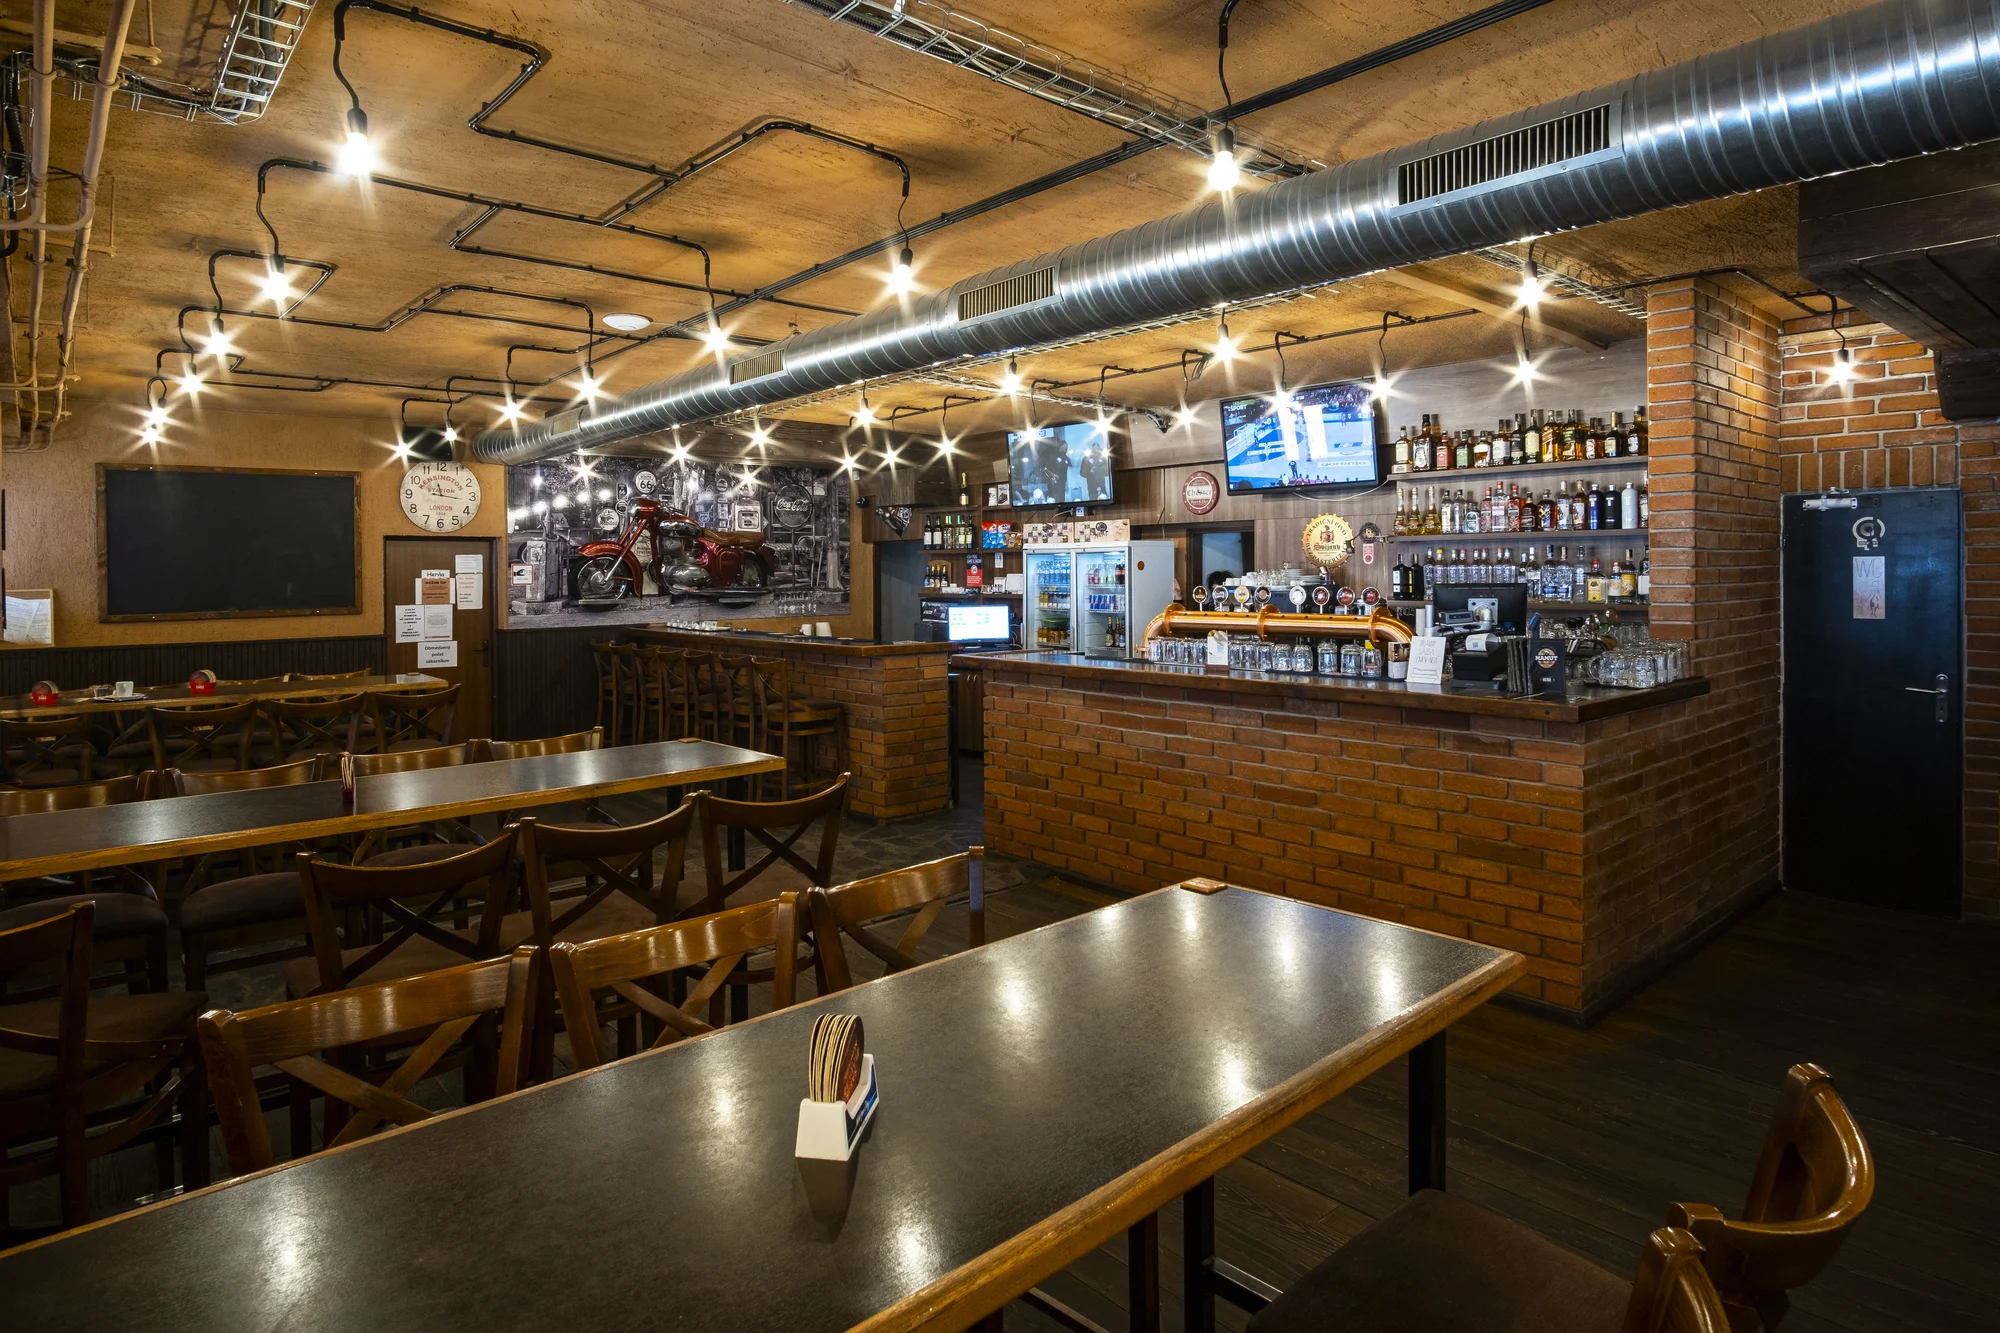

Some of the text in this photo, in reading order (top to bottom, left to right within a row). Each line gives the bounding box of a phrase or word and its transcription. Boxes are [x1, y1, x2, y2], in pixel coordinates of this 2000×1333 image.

[423, 465, 430, 475] 11
[436, 462, 448, 472] 12
[455, 466, 459, 475] 1
[410, 475, 421, 485] 10
[418, 474, 464, 491] KENSINGTON
[465, 477, 473, 488] 2
[640, 480, 653, 489] 66
[405, 488, 413, 499] 9
[468, 491, 477, 502] 3
[409, 503, 418, 514] 8
[462, 505, 470, 516] 4
[422, 514, 431, 525] 7
[436, 518, 445, 529] 6
[451, 515, 460, 526] 5
[1306, 518, 1347, 537] TRADIČNÍ PIVO
[1854, 557, 1884, 579] WC
